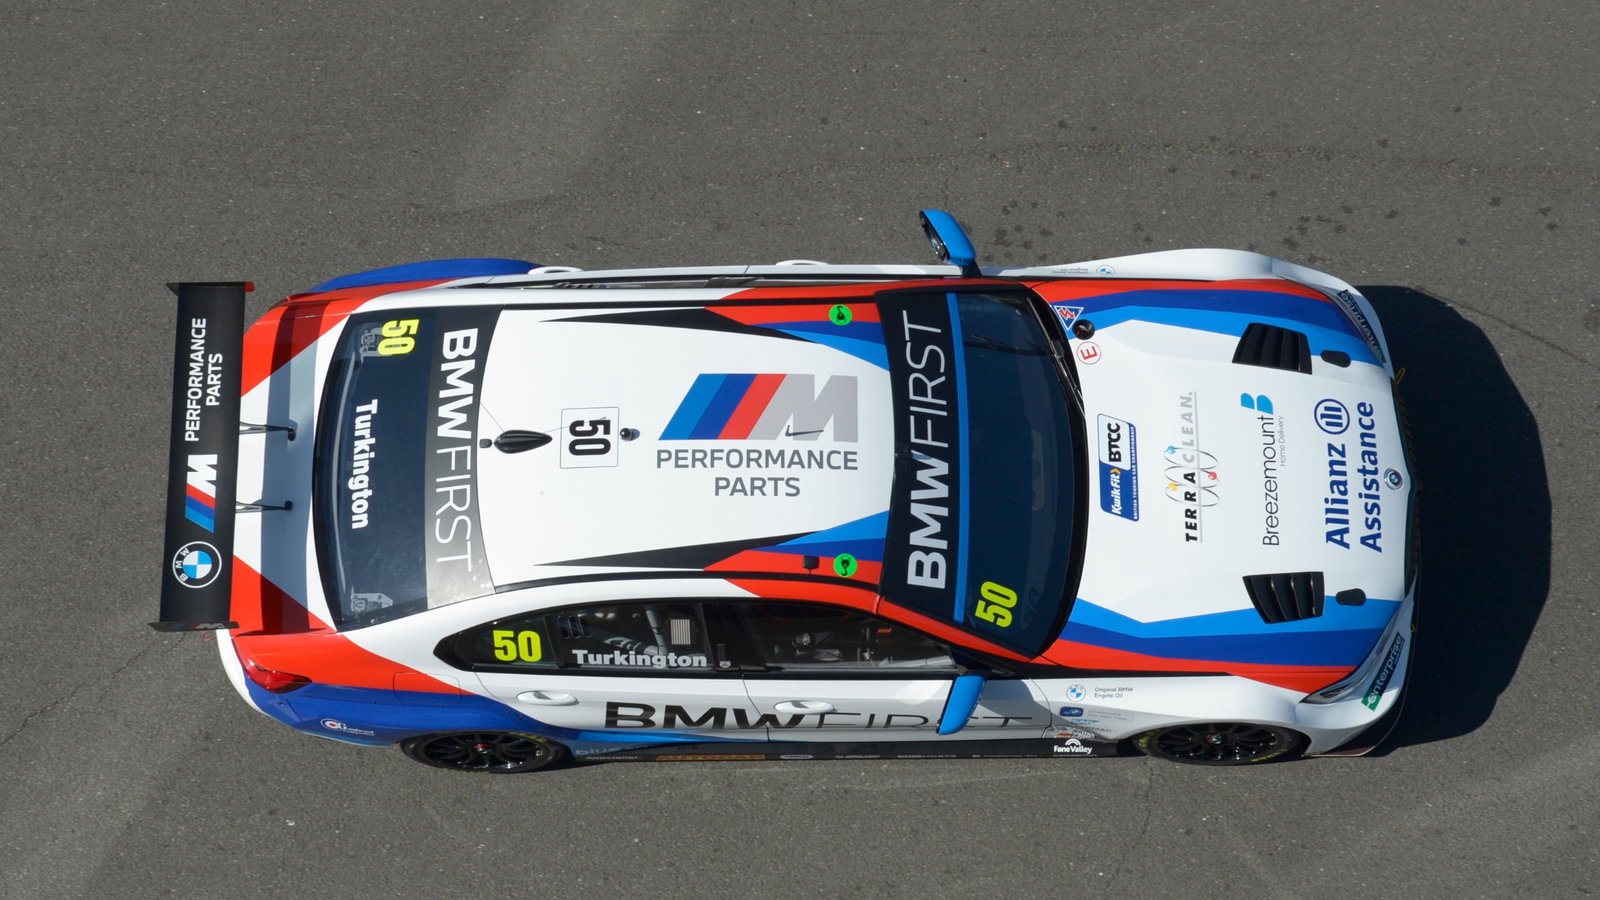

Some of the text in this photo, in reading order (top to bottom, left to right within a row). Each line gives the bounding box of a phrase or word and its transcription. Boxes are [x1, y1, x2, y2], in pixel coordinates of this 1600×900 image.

[377, 318, 420, 356] 50
[1080, 345, 1098, 360] E
[185, 318, 206, 441] PERFORMANCE
[206, 353, 223, 406] PARTS
[568, 419, 611, 456] 50
[656, 448, 859, 471] PERFORMANCE
[1107, 422, 1122, 462] BTCC
[1278, 415, 1287, 466] Home Delivery
[348, 399, 378, 529] Turkington
[714, 476, 801, 497] PARTS
[1257, 414, 1280, 546] Breezemount
[1356, 401, 1382, 553] Assistance
[1324, 442, 1350, 550] Allianz
[974, 580, 1018, 628] 50
[492, 629, 542, 663] 50
[572, 649, 708, 669] Turkington
[1366, 636, 1401, 707] enterprise
